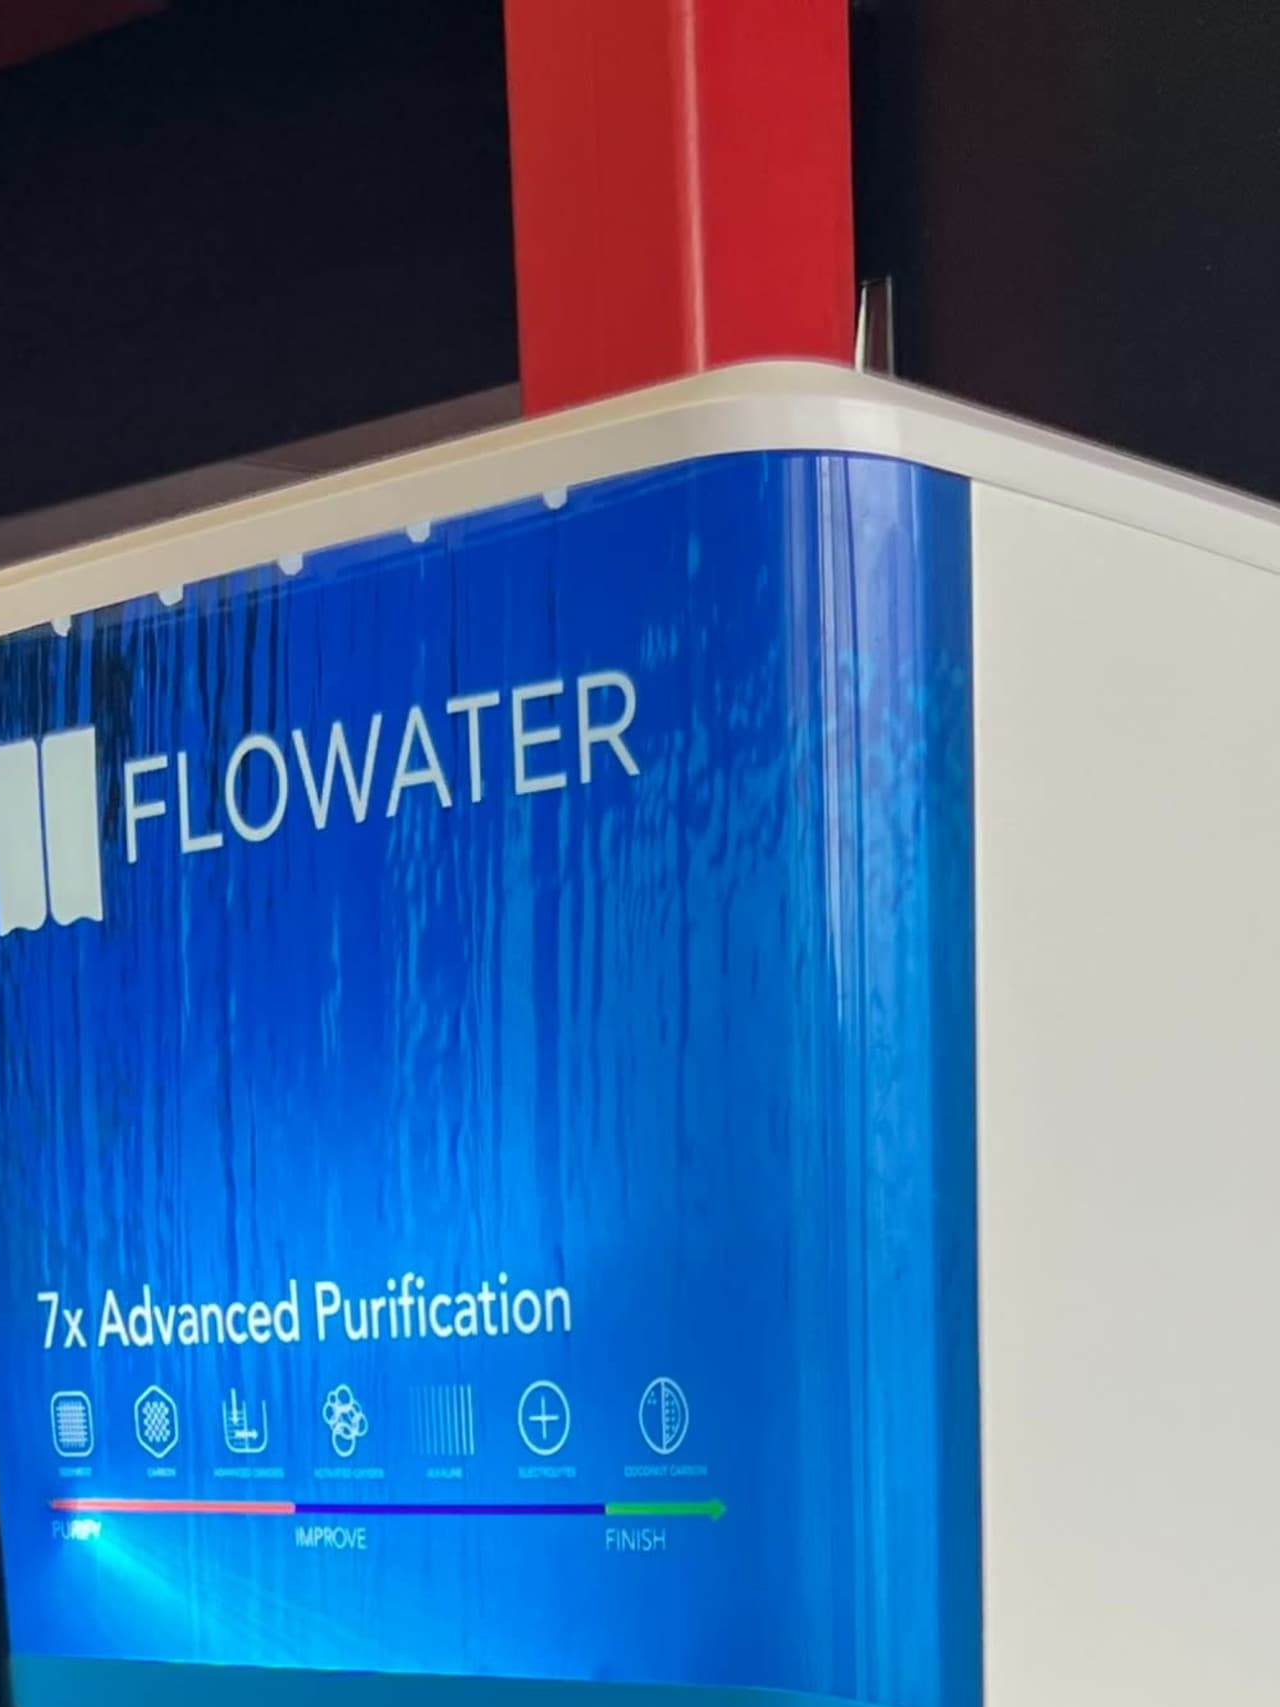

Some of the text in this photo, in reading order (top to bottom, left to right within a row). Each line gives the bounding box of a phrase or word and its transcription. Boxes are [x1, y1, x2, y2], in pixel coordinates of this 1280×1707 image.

[123, 669, 641, 865] FLOWATER
[36, 1271, 573, 1351] 7x Advanced Purification
[623, 1464, 708, 1478] COCONUT CARBON
[295, 1526, 367, 1550] IMPROVE
[605, 1528, 667, 1551] FINISH
